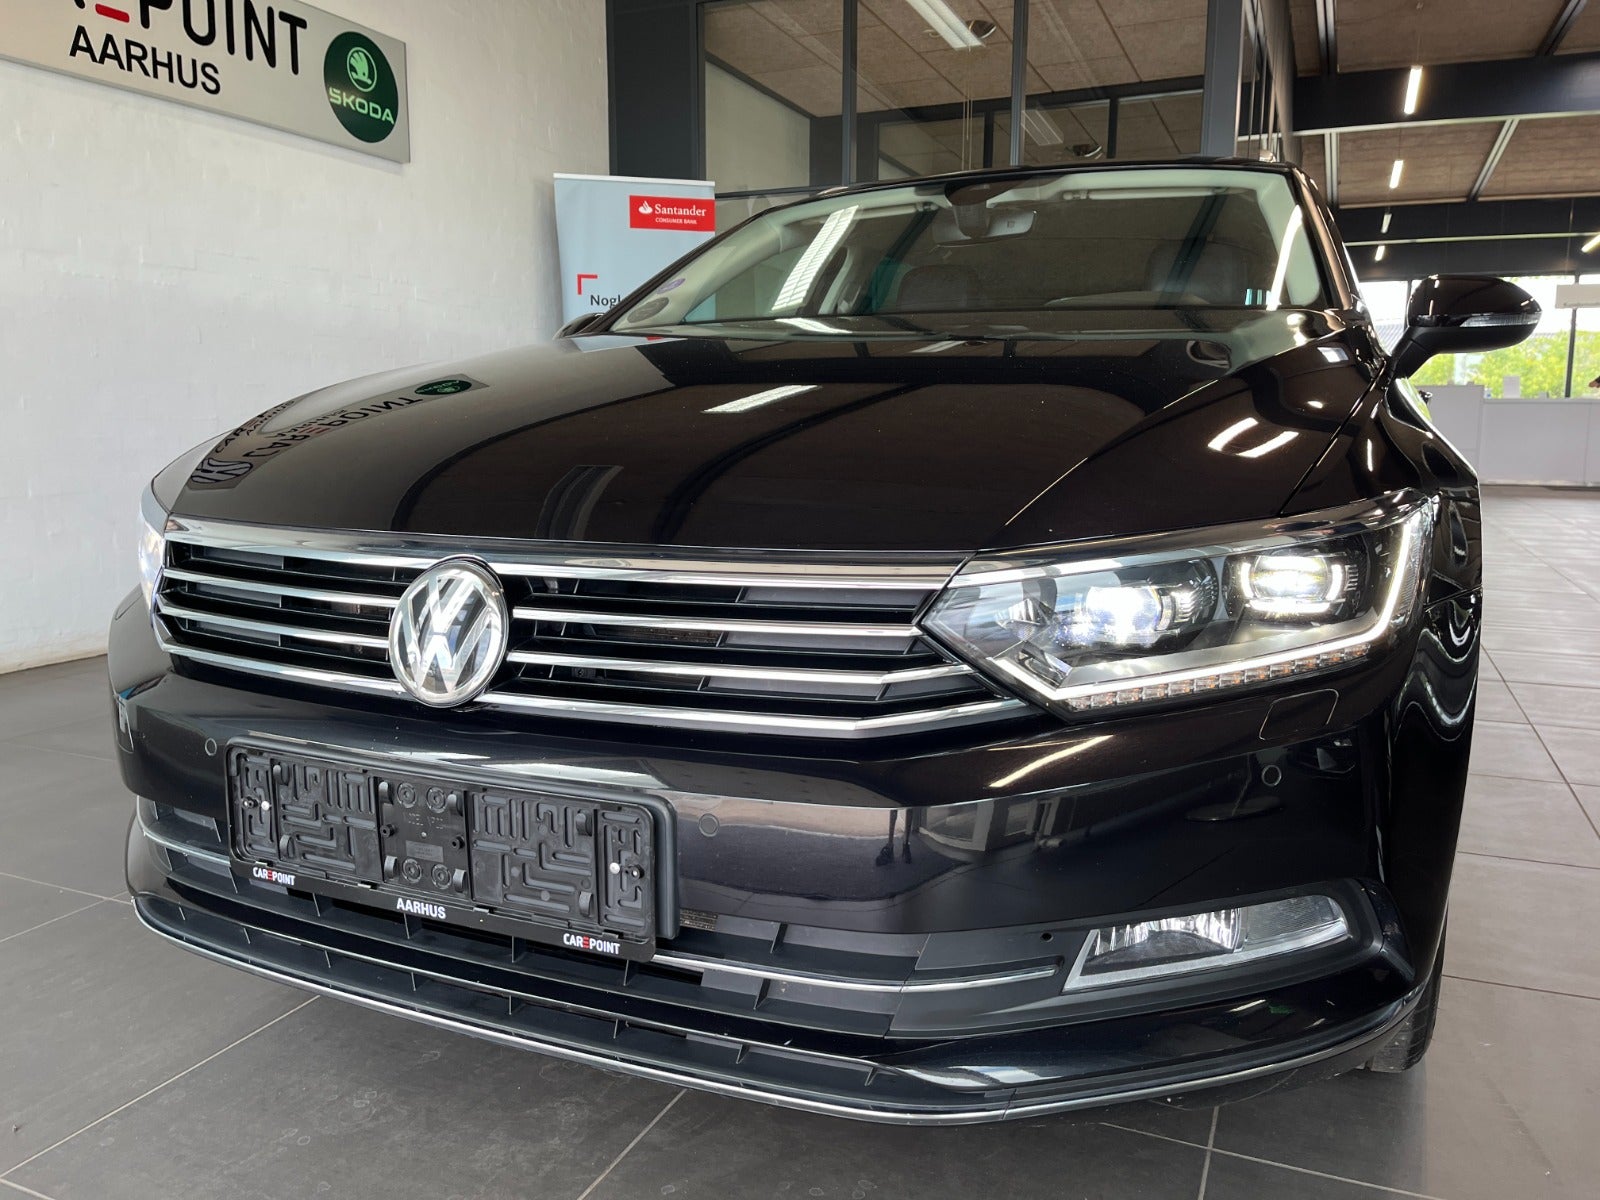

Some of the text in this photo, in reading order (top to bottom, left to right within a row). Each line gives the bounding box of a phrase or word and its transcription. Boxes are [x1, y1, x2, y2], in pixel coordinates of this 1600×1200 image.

[69, 24, 221, 95] AARHUS
[329, 87, 394, 124] SKODA
[654, 203, 707, 217] Santander
[396, 897, 446, 919] AARHUS
